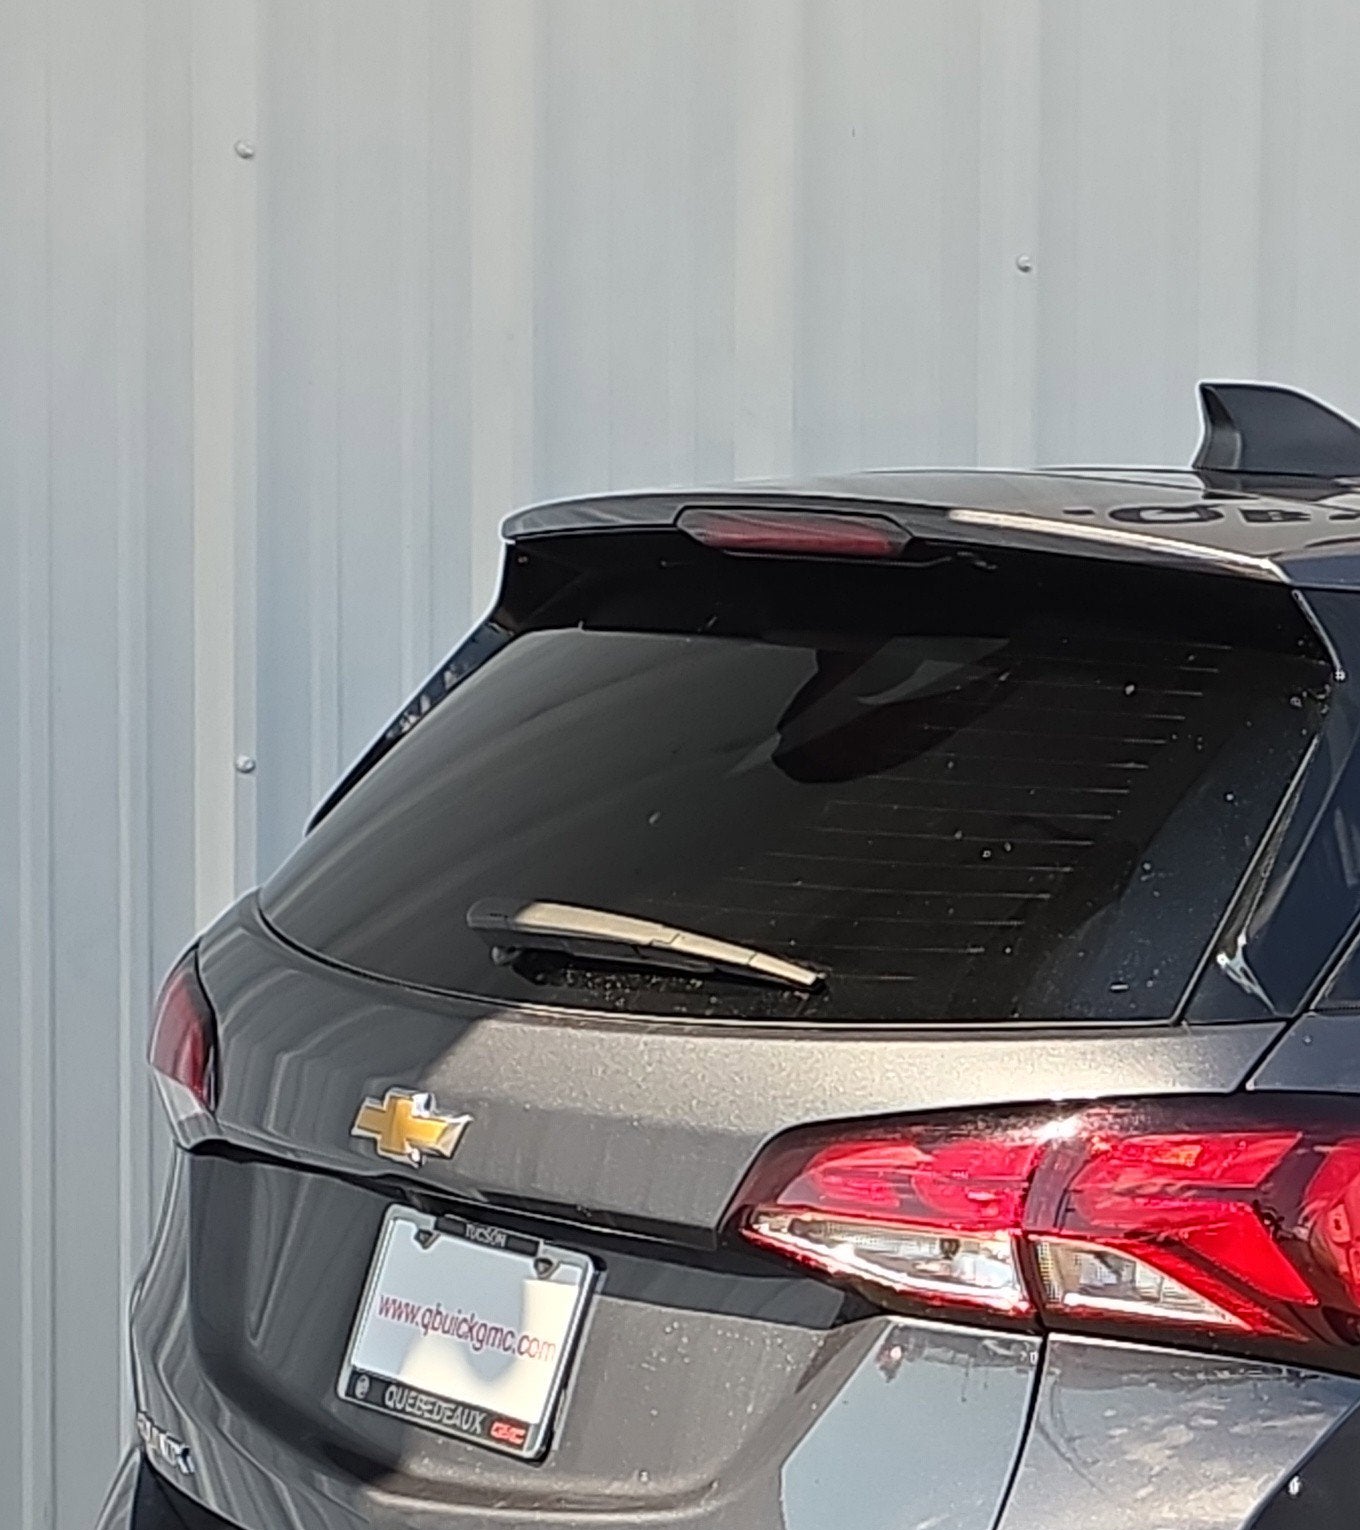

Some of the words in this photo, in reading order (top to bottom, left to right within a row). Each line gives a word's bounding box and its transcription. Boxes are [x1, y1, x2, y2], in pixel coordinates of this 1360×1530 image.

[464, 1222, 508, 1248] TUCSON
[377, 1294, 556, 1362] www.qbuickgmc.com
[384, 1384, 487, 1435] QUEBEDEAUX
